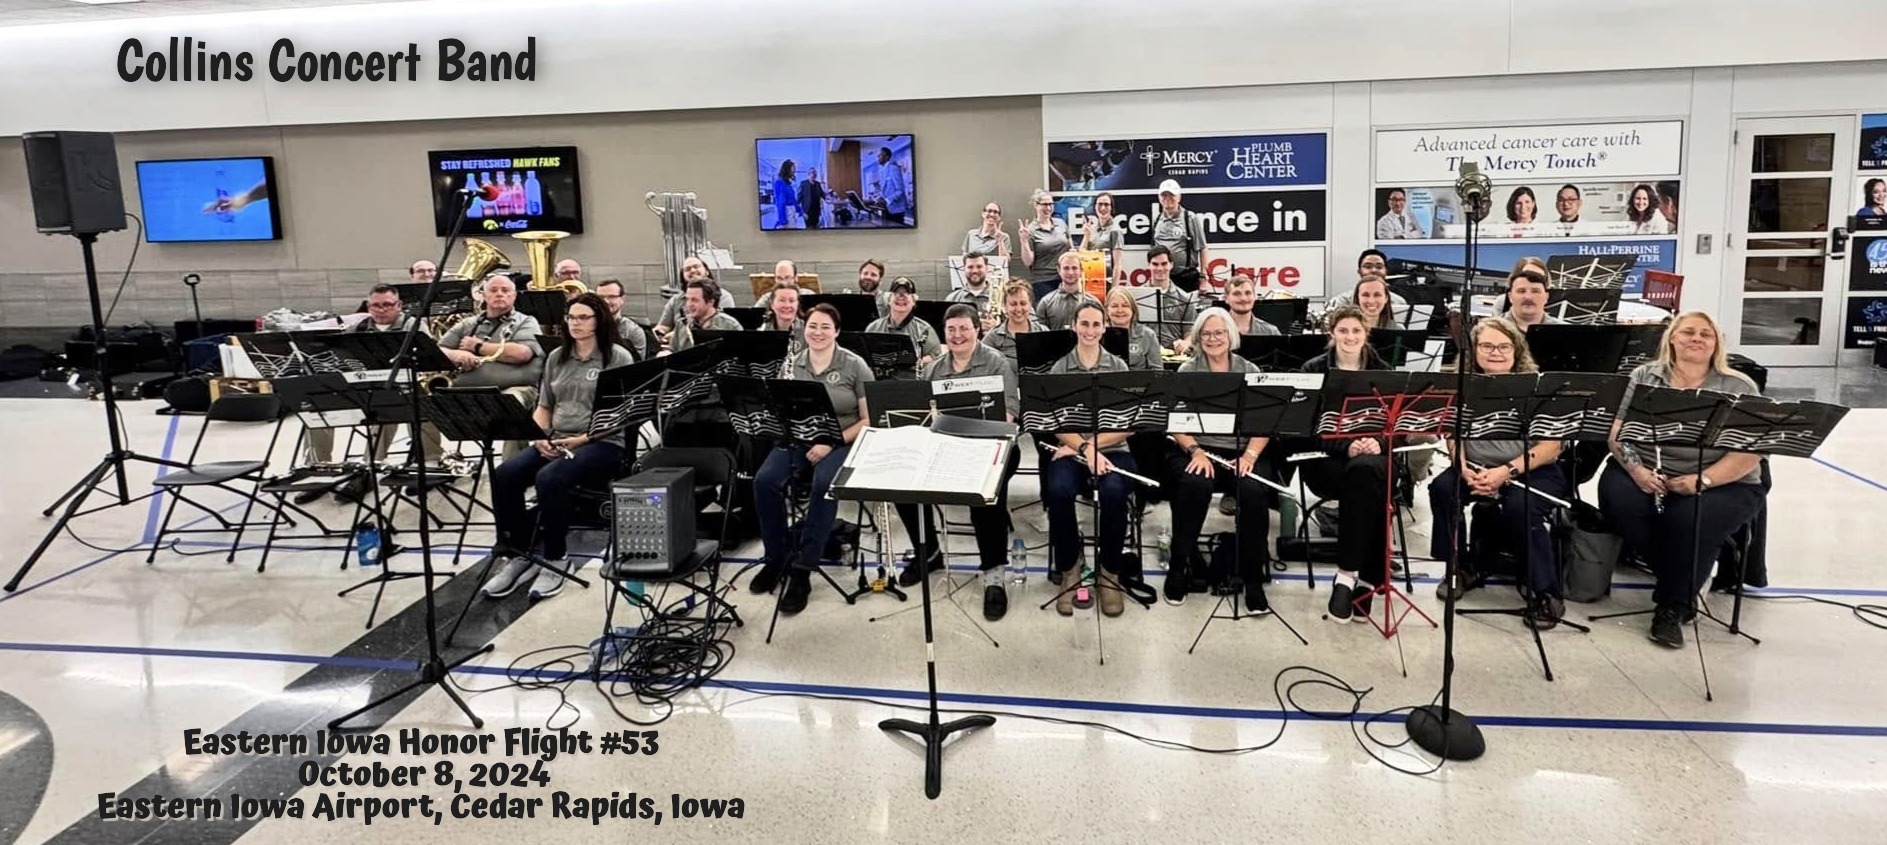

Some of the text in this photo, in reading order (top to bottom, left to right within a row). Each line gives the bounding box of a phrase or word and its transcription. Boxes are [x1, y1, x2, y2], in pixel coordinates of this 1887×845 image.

[1251, 142, 1292, 153] PLUMB
[1413, 130, 1641, 152] Advanced cancer care with
[440, 156, 560, 170] STAY REFRESHED HAWK FANS
[1231, 147, 1294, 166] HEART
[1484, 155, 1538, 173] Mercy
[1226, 161, 1297, 180] CENTER
[1273, 200, 1307, 232] in
